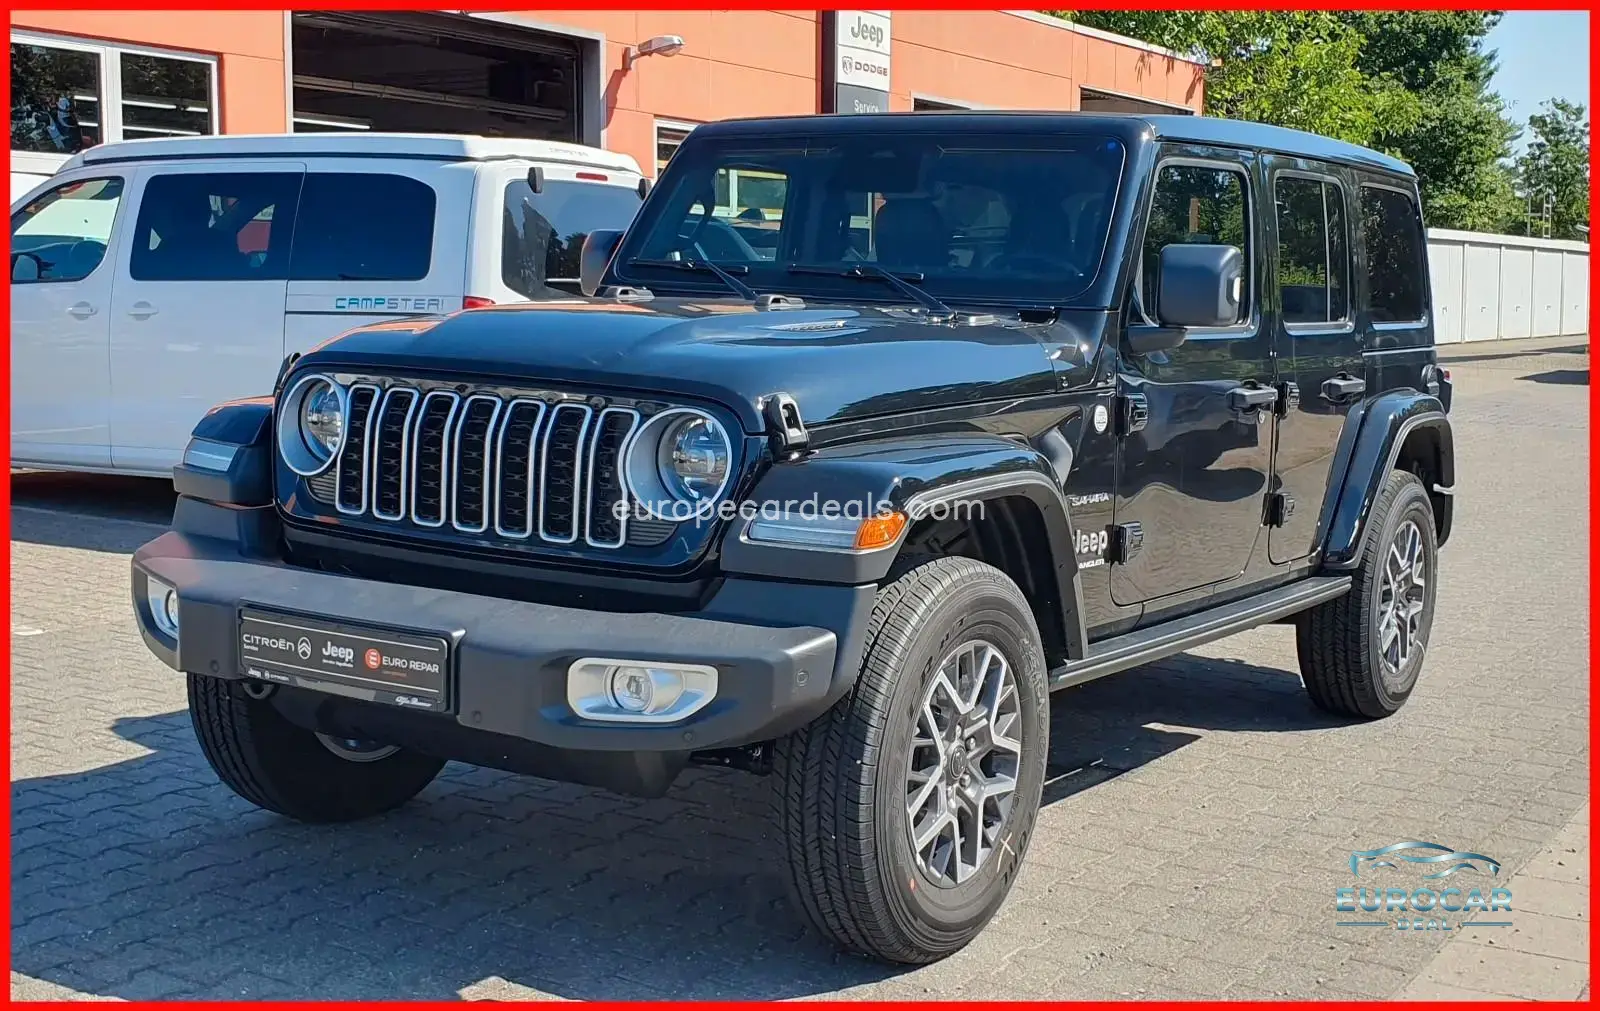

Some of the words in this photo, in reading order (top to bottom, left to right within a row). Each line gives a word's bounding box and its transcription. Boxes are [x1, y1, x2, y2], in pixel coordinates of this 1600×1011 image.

[850, 15, 884, 48] Jeep
[854, 61, 888, 77] DODGE
[1069, 492, 1110, 507] SAHARA
[1073, 529, 1109, 555] Jeep
[321, 641, 354, 663] Jeep
[382, 656, 408, 669] EURO
[408, 660, 440, 674] REPAR
